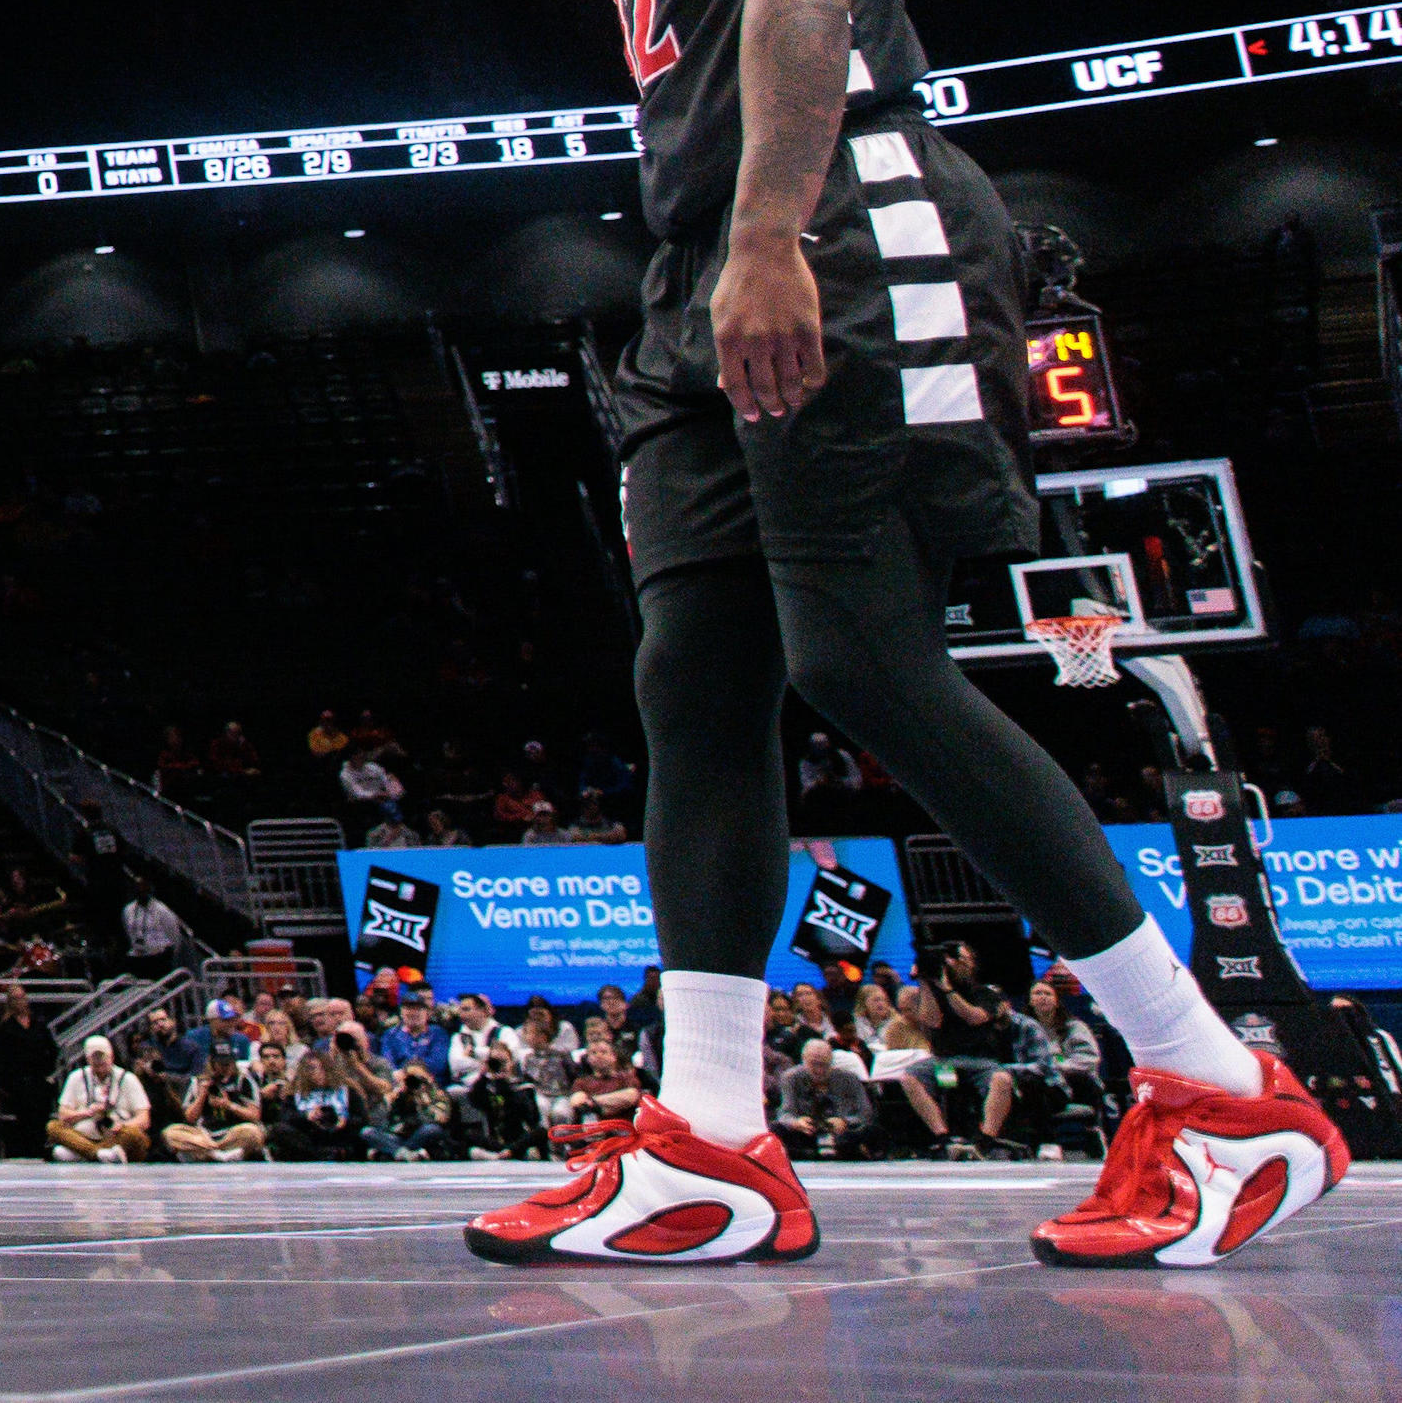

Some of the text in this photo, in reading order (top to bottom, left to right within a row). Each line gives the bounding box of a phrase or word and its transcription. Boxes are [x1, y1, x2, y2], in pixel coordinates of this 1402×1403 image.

[1289, 8, 1402, 58] 4:14
[1071, 51, 1164, 92] UCF
[103, 148, 158, 167] TEAM
[204, 155, 272, 182] 8/26
[302, 149, 353, 176] 2/9
[408, 141, 460, 169] 2/3
[497, 136, 535, 163] 18
[564, 132, 587, 158] 5
[37, 171, 58, 195] 0
[104, 167, 163, 186] STATS
[502, 369, 570, 390] Mobile
[1045, 365, 1096, 426] 5
[452, 869, 642, 899] Score more
[1297, 875, 1402, 906] Debit
[469, 898, 654, 930] Venmo Deb
